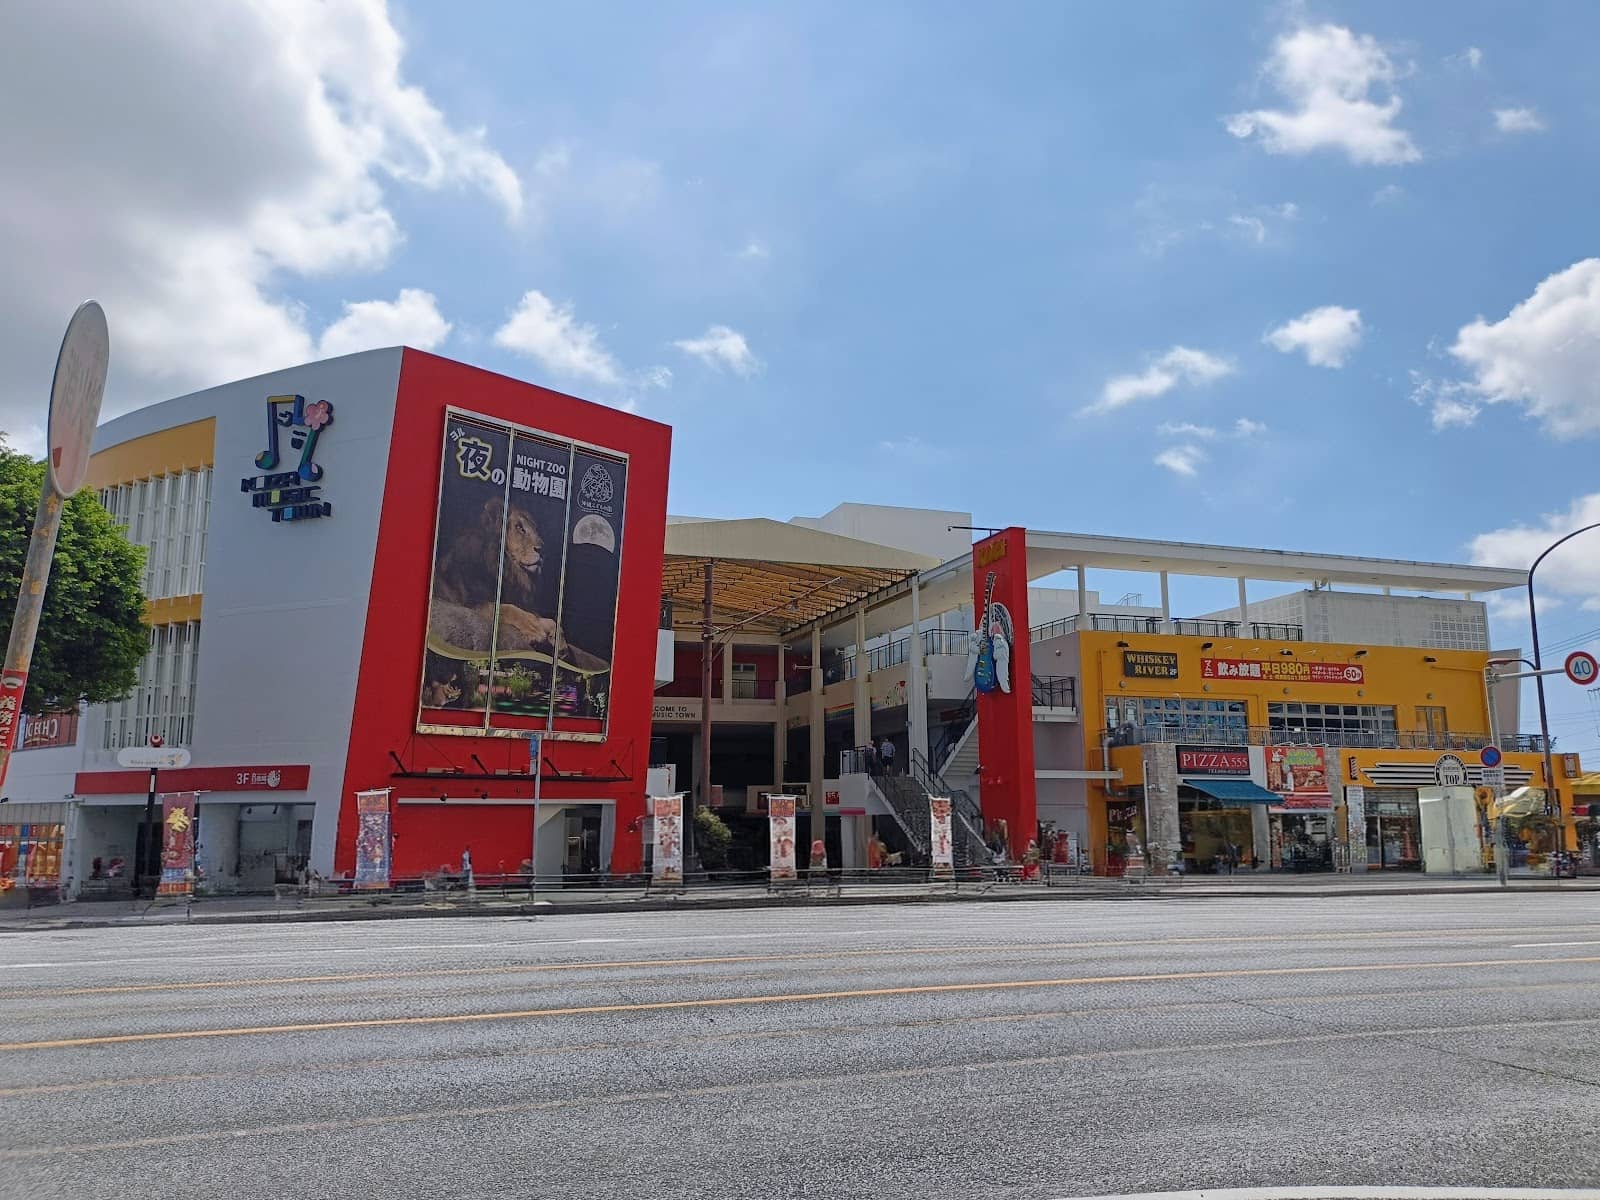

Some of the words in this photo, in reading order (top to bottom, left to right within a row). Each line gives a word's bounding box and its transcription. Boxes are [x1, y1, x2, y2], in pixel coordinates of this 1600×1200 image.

[516, 454, 546, 470] NIGHT
[547, 461, 566, 475] ZOO
[512, 467, 567, 500] 動物園
[1126, 653, 1177, 665] WHISKEY
[1135, 664, 1168, 675] RIVER
[1217, 662, 1261, 678] 飲み放題
[1261, 662, 1310, 675] 平日980円
[1574, 660, 1591, 676] 40
[1183, 753, 1230, 768] PIZZA
[236, 772, 250, 785] 3F
[1445, 774, 1460, 785] TOP
